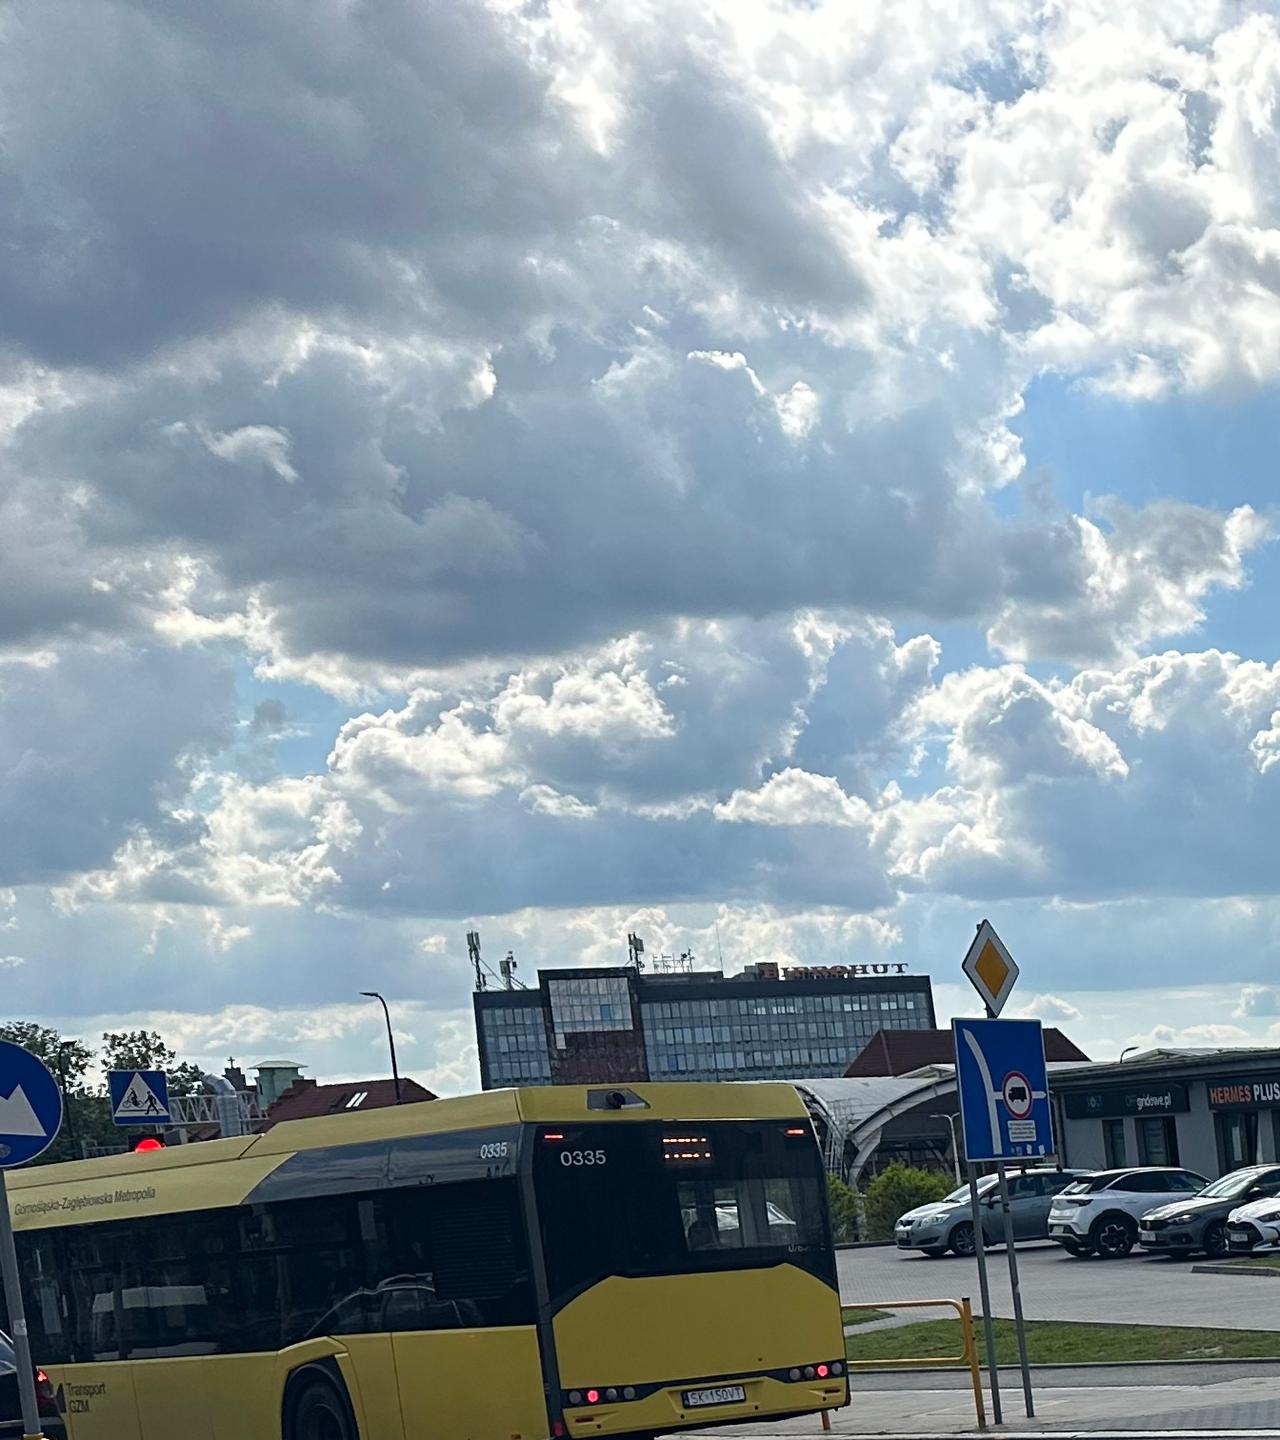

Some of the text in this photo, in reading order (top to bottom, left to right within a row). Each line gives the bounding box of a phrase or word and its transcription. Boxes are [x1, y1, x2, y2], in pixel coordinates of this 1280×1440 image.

[1210, 1082, 1280, 1104] HERMES PLUS
[480, 1142, 508, 1159] 0335
[560, 1150, 607, 1167] 0335
[114, 1186, 156, 1203] Metropolia
[66, 1382, 106, 1398] Transport
[70, 1400, 89, 1413] GZM
